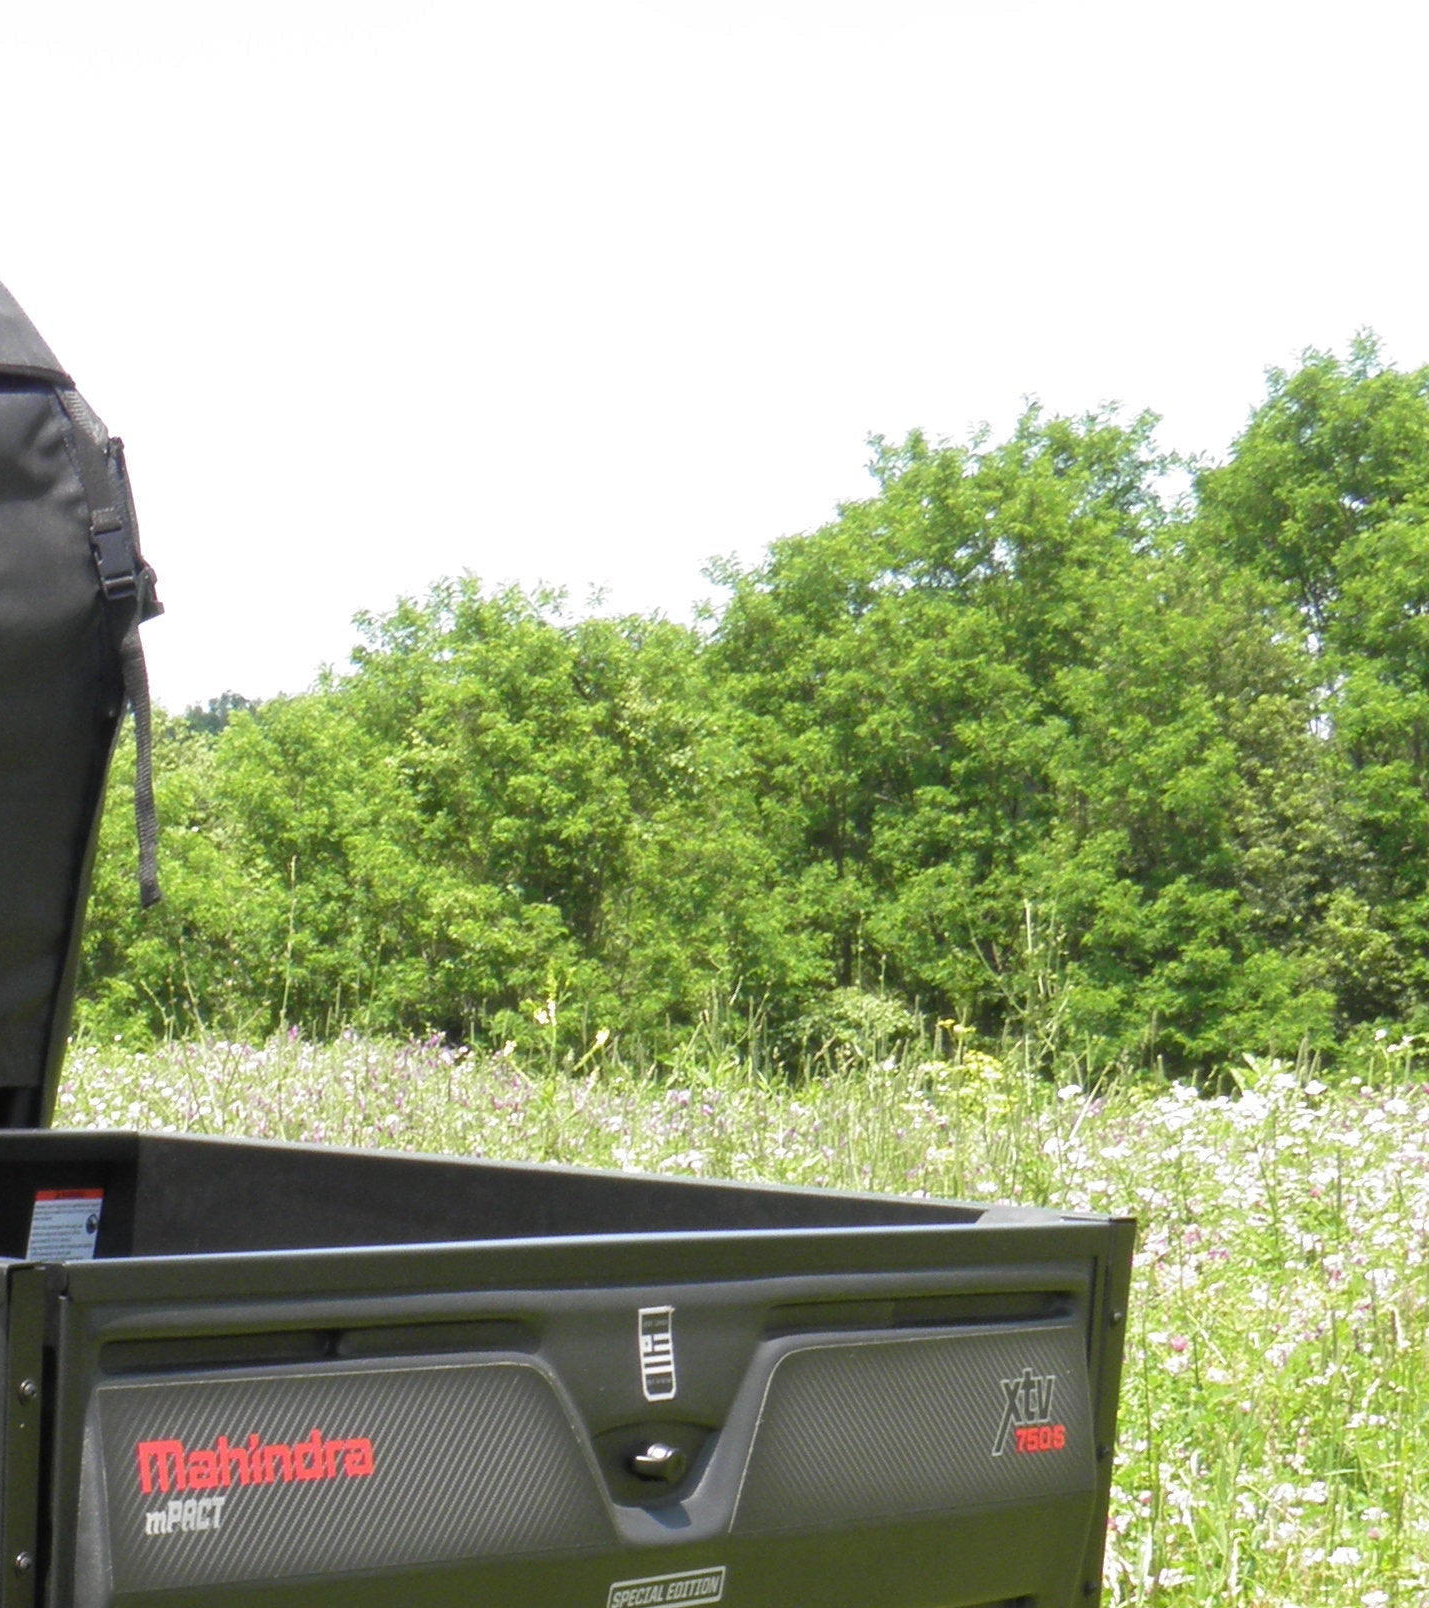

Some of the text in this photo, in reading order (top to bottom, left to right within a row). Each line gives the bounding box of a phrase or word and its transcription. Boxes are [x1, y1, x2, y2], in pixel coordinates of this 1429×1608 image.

[1015, 1424, 1066, 1455] 750S
[137, 1427, 375, 1495] Mahindra
[145, 1496, 226, 1535] mPACT
[666, 1575, 720, 1601] EDITION
